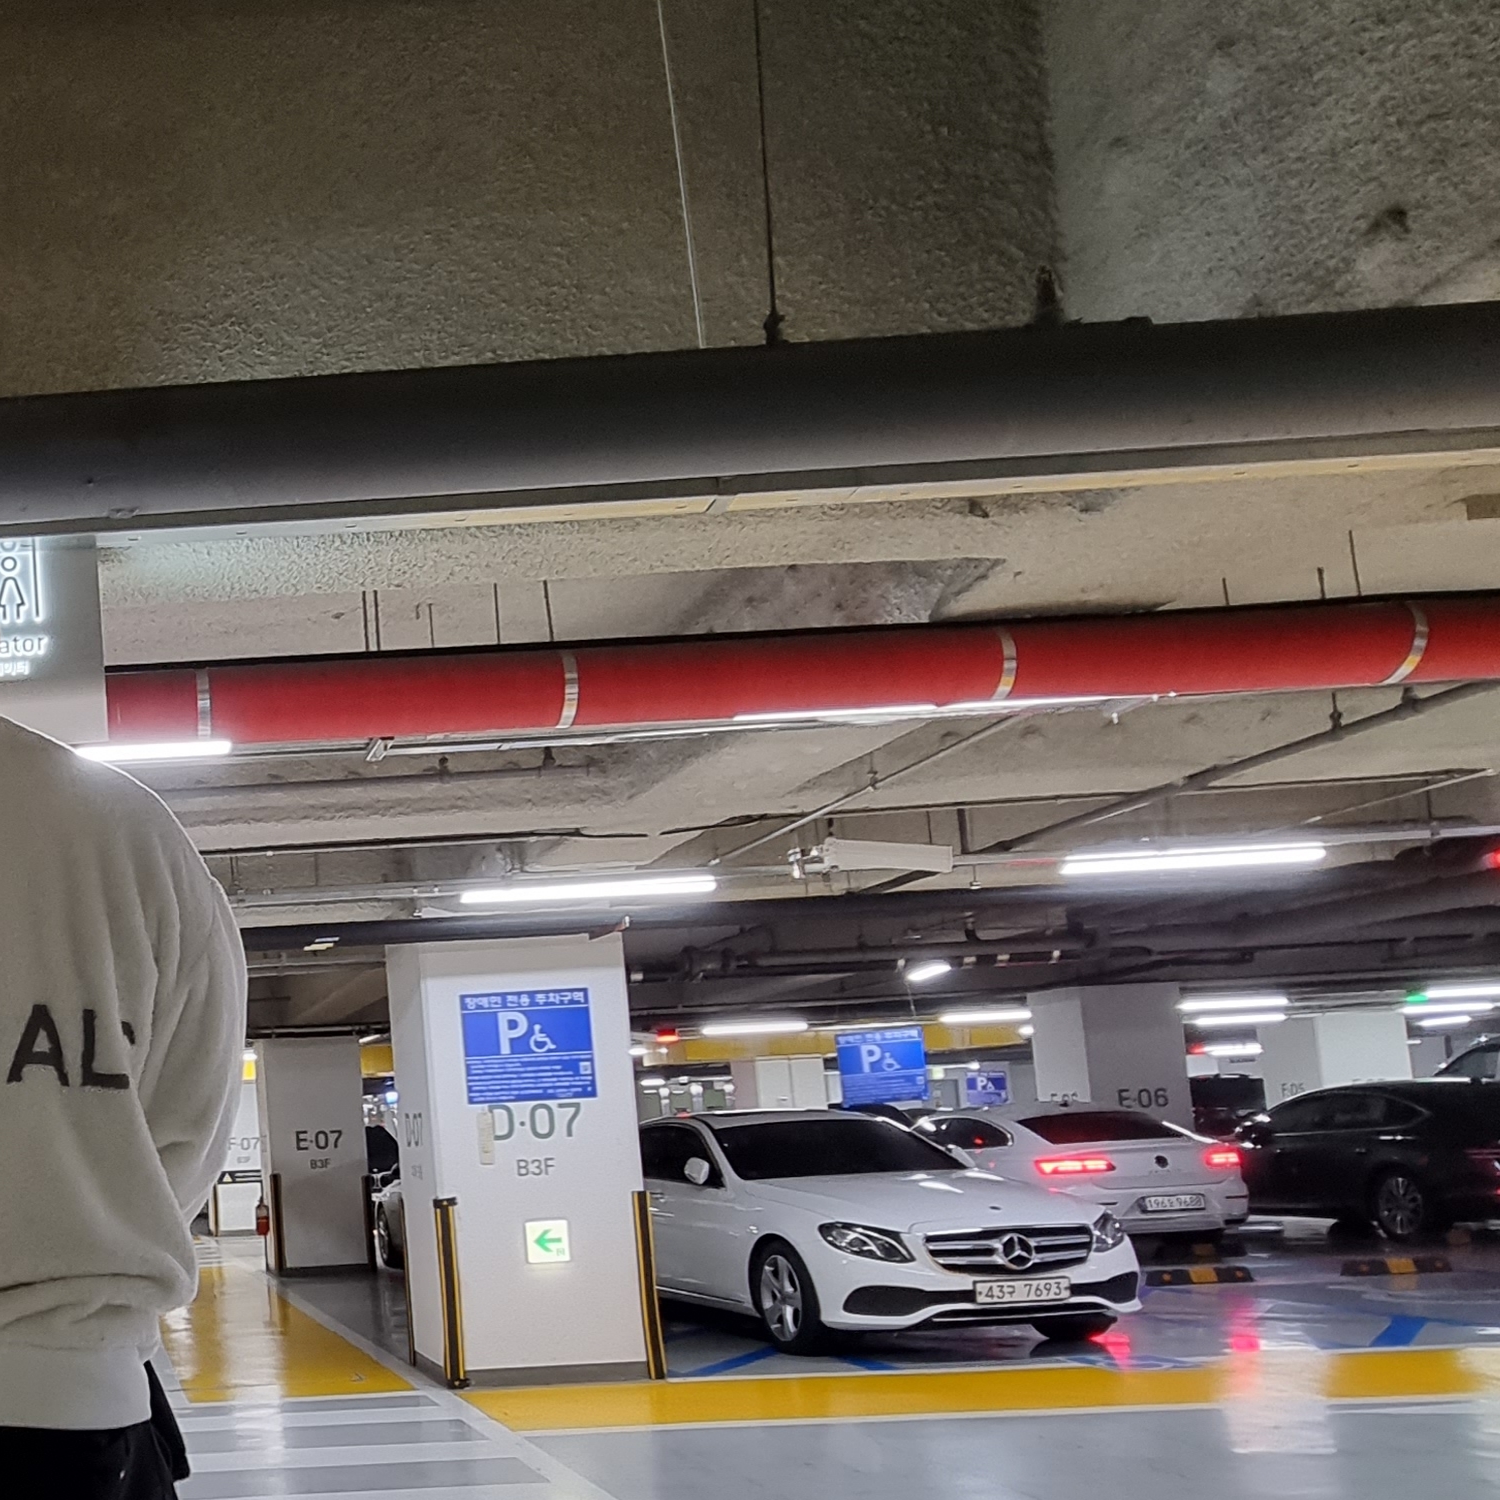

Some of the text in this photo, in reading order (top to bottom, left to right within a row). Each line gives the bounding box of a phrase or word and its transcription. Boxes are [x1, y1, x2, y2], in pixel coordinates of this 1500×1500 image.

[0, 636, 45, 654] ator
[497, 1011, 529, 1055] P
[860, 1044, 881, 1073] P
[309, 1158, 330, 1169] B3F
[516, 1157, 555, 1176] B3F
[1023, 1281, 1062, 1298] 7693
